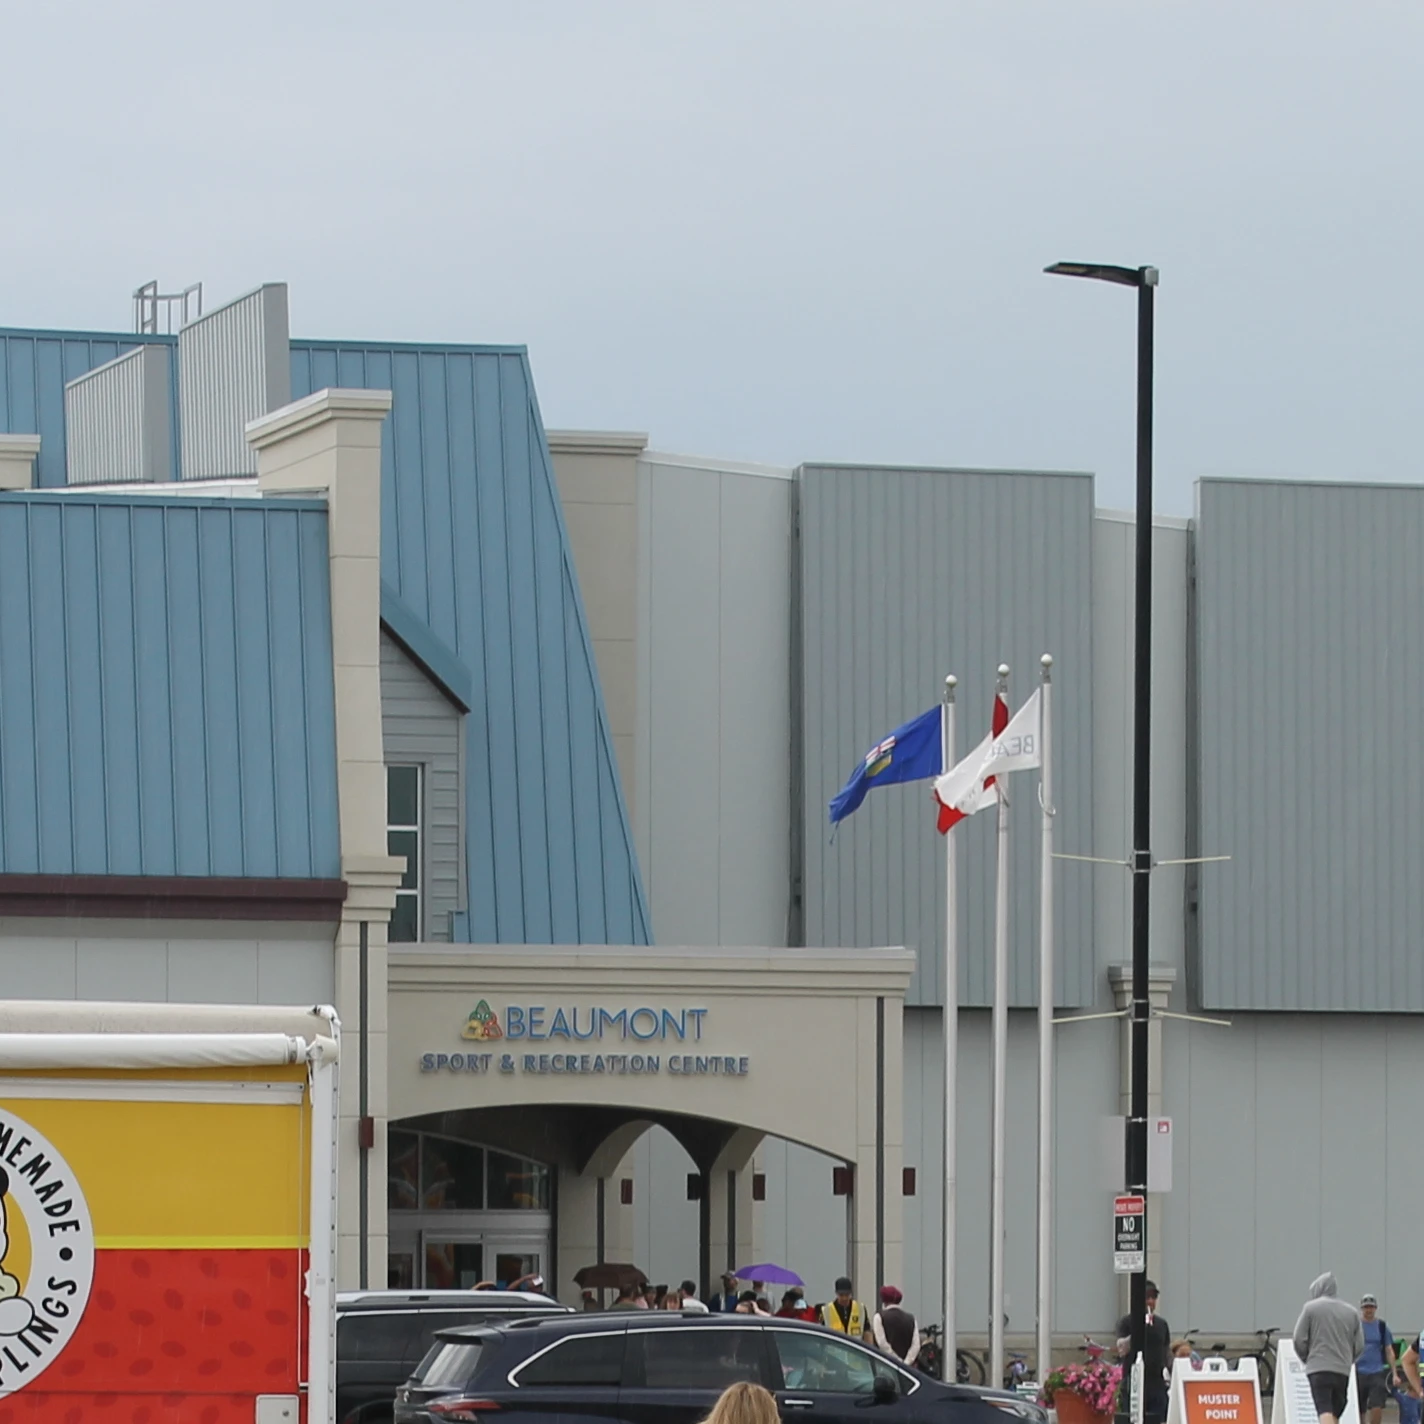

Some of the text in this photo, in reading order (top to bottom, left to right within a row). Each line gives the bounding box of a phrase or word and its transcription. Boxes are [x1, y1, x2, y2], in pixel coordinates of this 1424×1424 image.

[506, 1006, 708, 1039] BEAUMONT
[421, 1053, 749, 1076] SPORT & RECREATION CENTRE
[1122, 1216, 1135, 1232] NO
[1198, 1394, 1240, 1404] MUSTER
[1206, 1409, 1237, 1420] POINT
